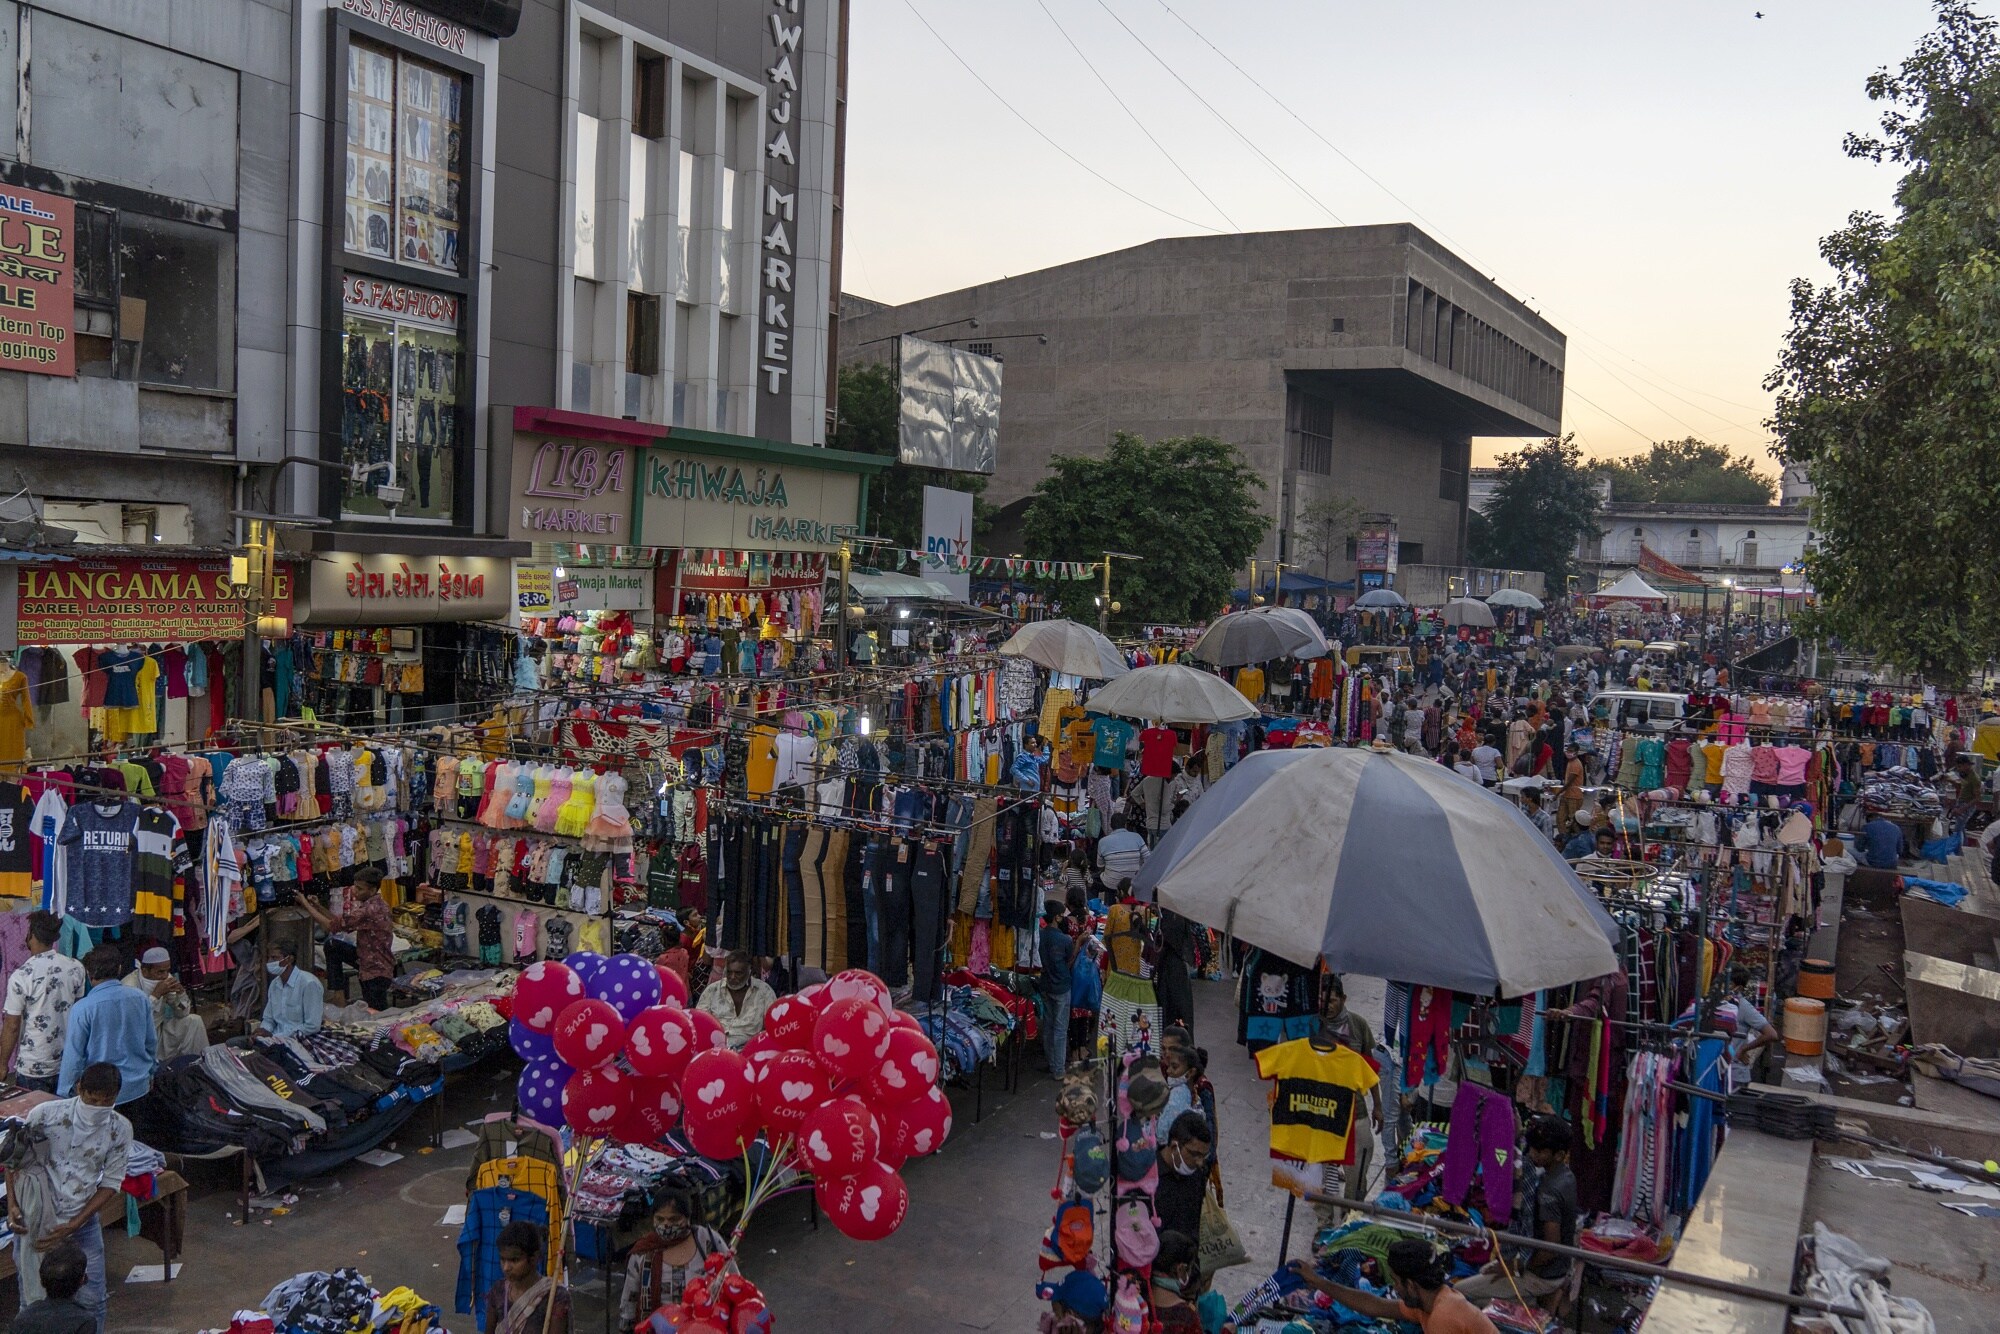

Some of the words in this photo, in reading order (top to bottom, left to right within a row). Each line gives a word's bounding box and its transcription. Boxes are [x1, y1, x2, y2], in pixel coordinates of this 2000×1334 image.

[763, 184, 795, 394] MARKET
[38, 322, 65, 342] Top
[525, 442, 626, 500] LIBA
[522, 506, 623, 534] MARKET
[750, 515, 859, 544] MARKET
[609, 575, 642, 589] Market
[24, 603, 82, 616] SAREE,
[88, 604, 142, 615] LADIES
[147, 603, 176, 614] TOP
[181, 603, 191, 614] &
[196, 603, 239, 614] KURTI
[44, 619, 79, 630] Chaniya
[81, 619, 104, 628] Choli
[161, 618, 181, 627] Kurti
[47, 630, 76, 639] Ladies
[79, 630, 104, 639] Jeans
[111, 629, 140, 638] Ladies
[178, 628, 204, 637] Blouse
[83, 831, 129, 846] RETURN
[564, 1006, 593, 1037] LOVE
[774, 1020, 800, 1038] LOVE
[781, 1055, 816, 1069] LOVE
[641, 1107, 663, 1133] LOVE
[706, 1101, 738, 1120] LOVE
[843, 1111, 866, 1163] LOVE
[839, 1174, 858, 1214] LOVE
[889, 1189, 908, 1230] LOVE
